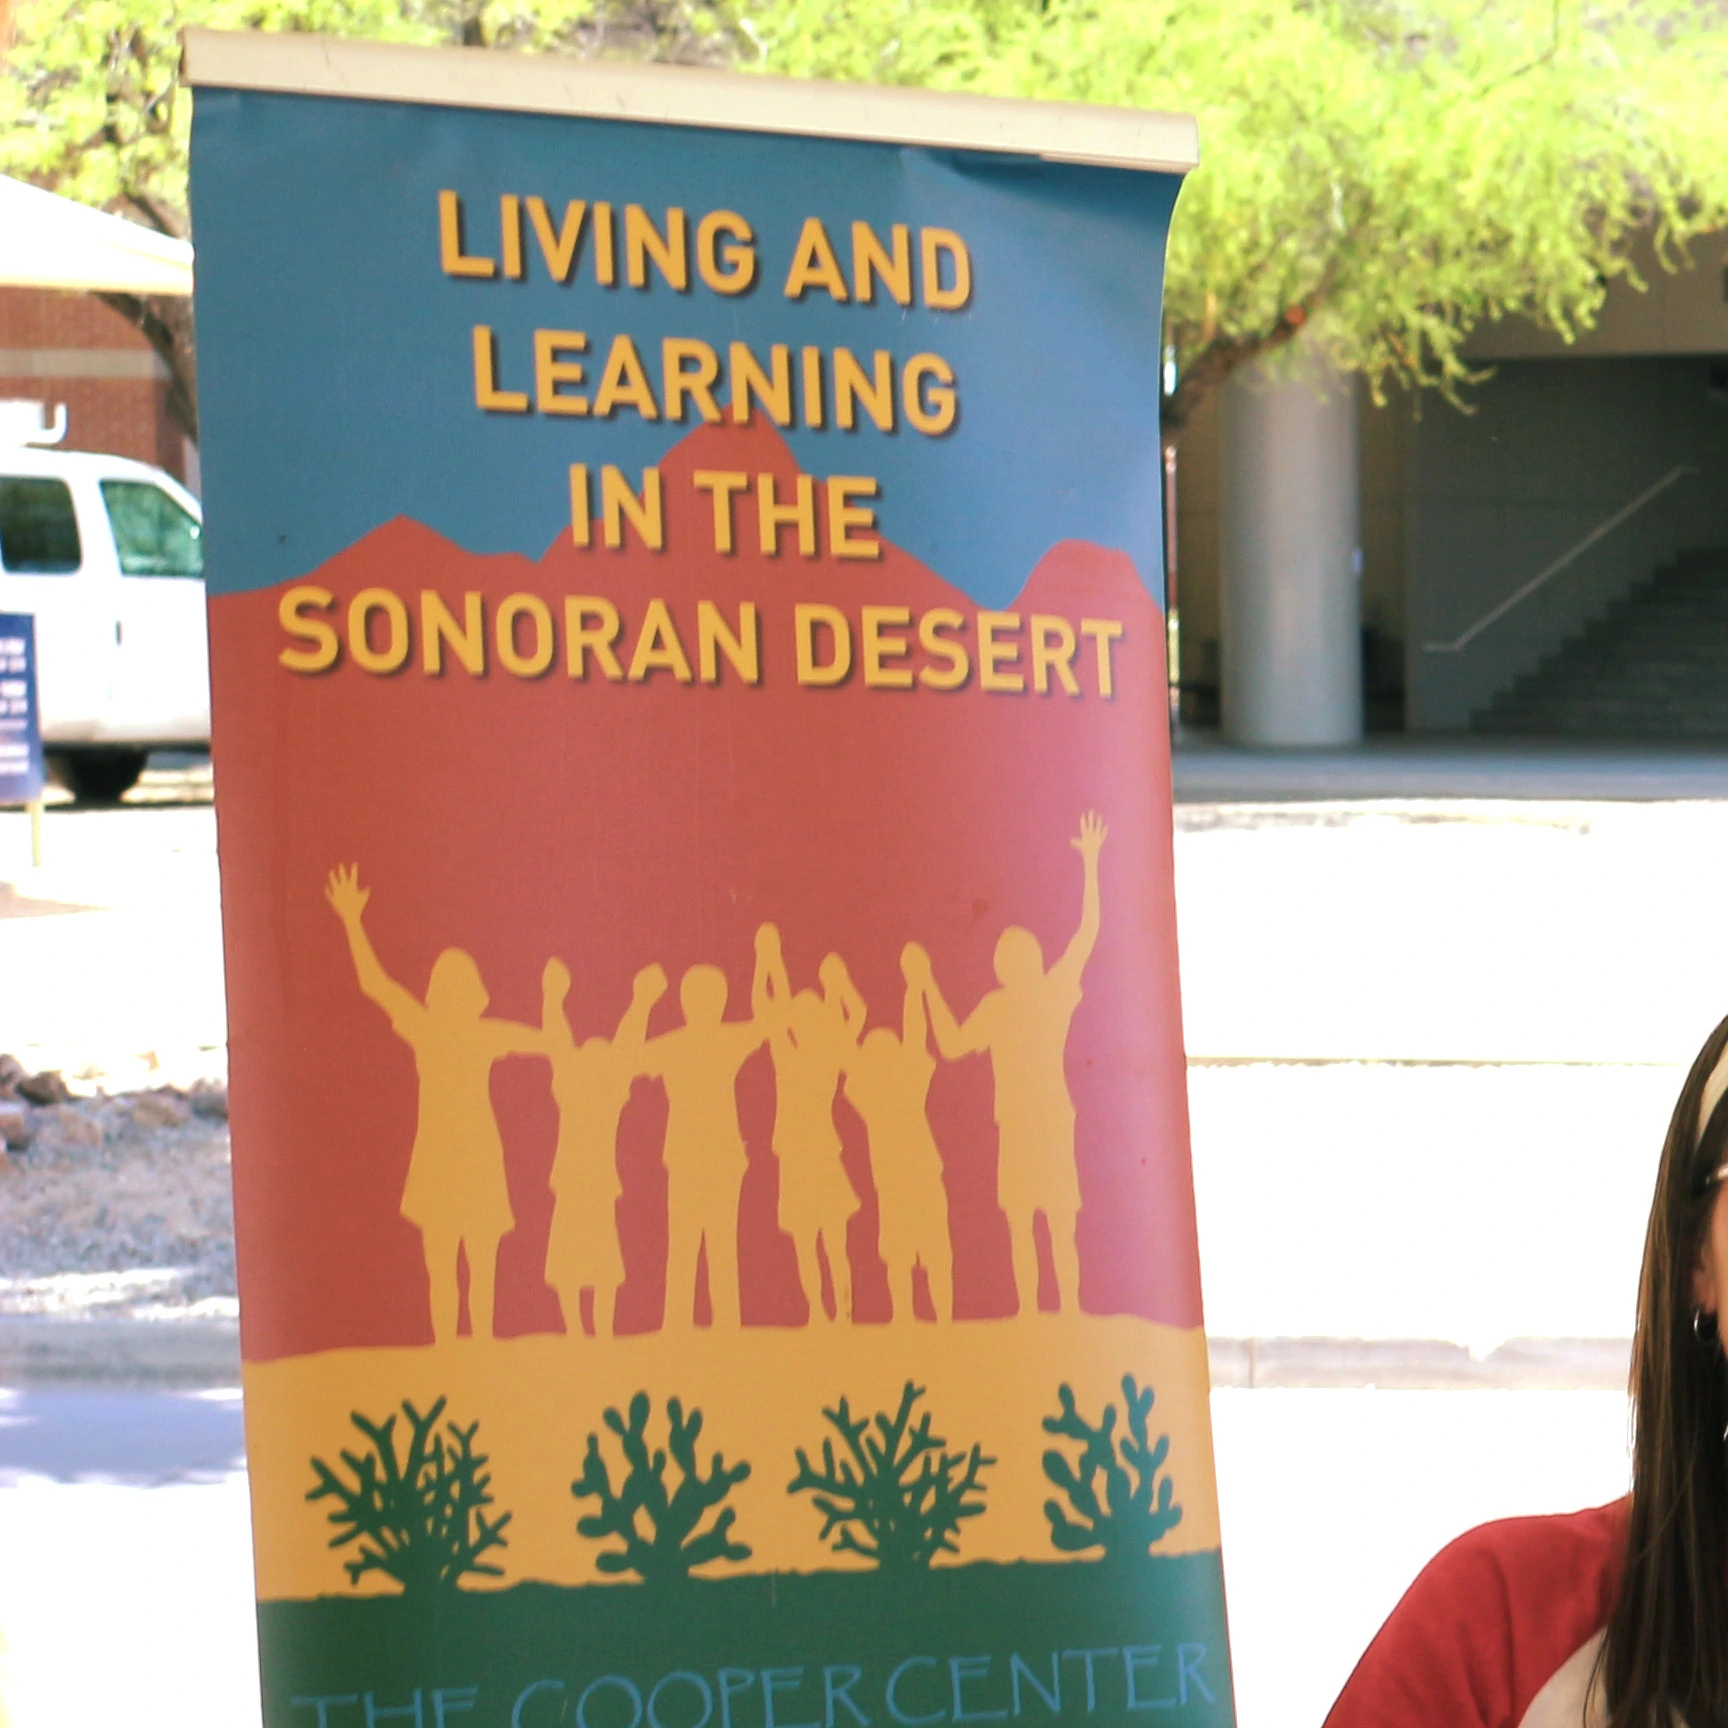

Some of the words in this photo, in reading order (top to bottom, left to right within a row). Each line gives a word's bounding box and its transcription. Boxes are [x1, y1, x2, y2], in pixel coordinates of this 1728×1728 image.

[437, 190, 756, 297] LIVING
[784, 216, 971, 310] AND
[472, 323, 958, 436] LEARNING
[568, 462, 664, 552] IN
[694, 468, 881, 559] THE
[277, 586, 761, 685] SONORAN
[797, 604, 1123, 700] DESERT
[886, 1641, 1216, 1726] CENTER
